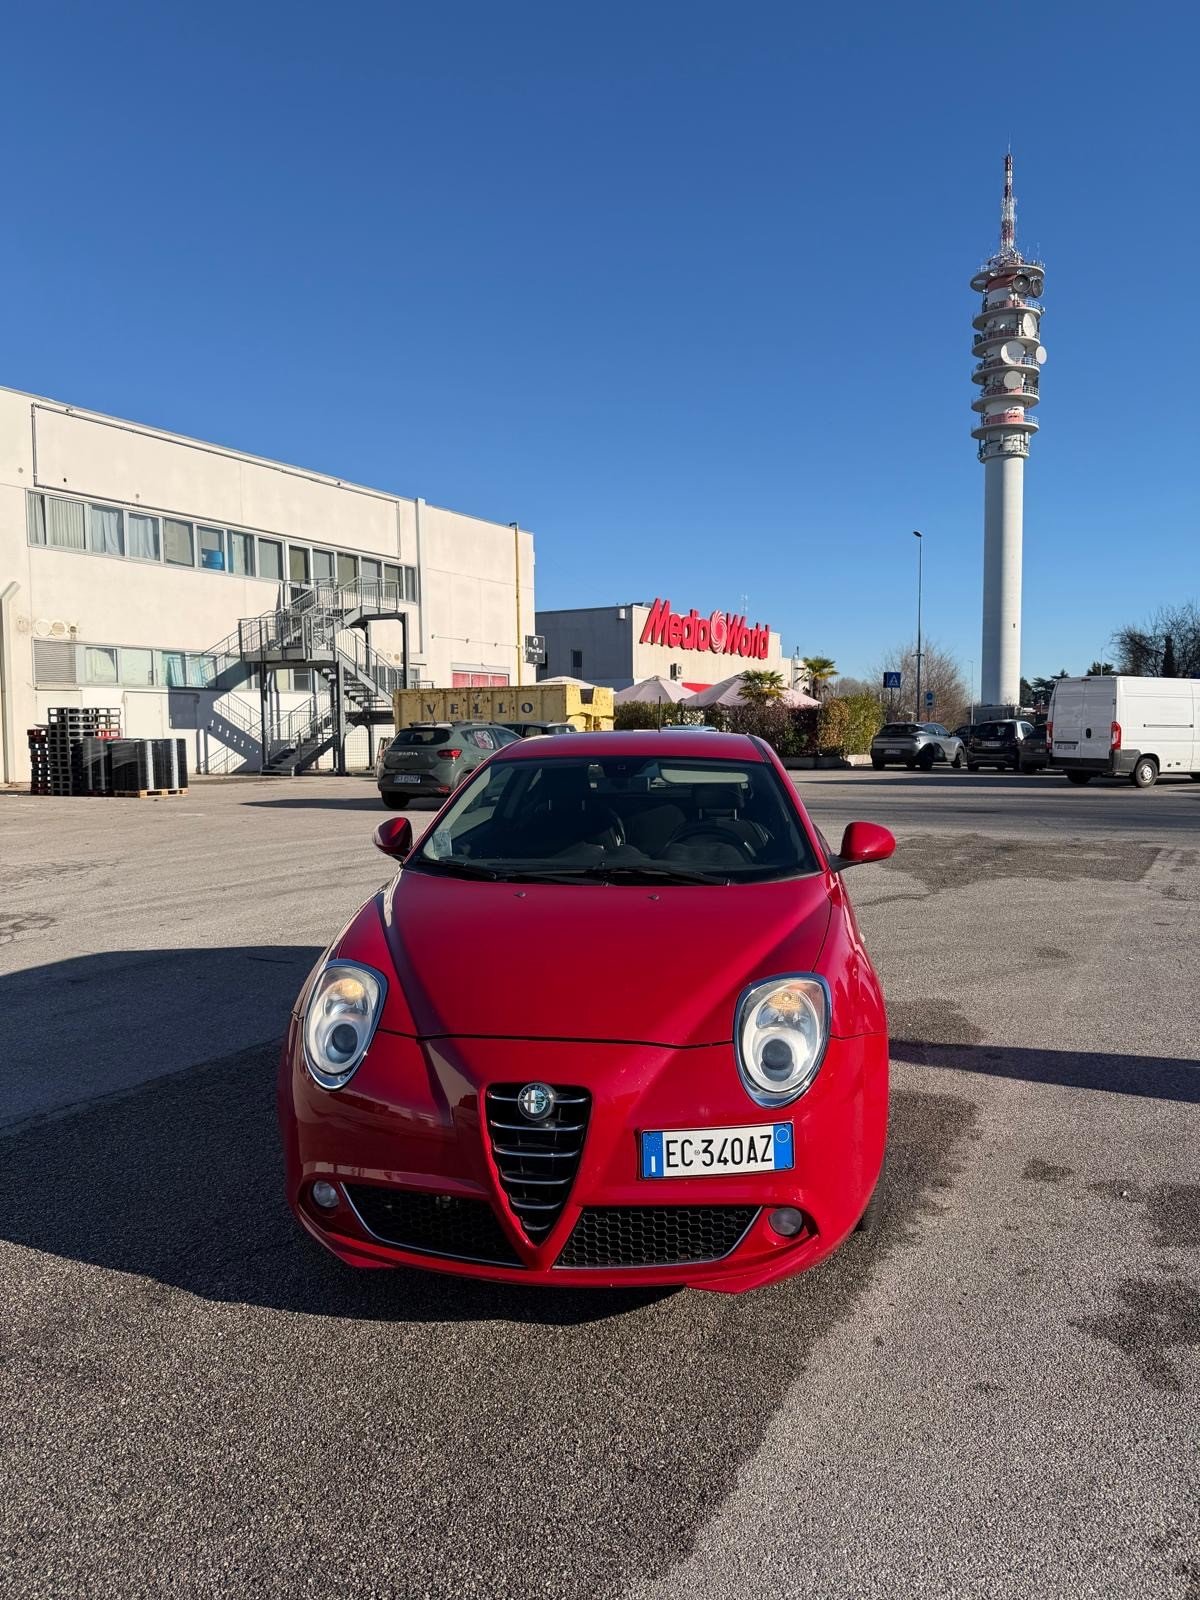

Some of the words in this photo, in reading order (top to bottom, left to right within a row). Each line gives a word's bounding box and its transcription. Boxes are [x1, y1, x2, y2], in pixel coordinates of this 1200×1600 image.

[426, 702, 534, 714] VELLO
[666, 1139, 694, 1168] EC
[701, 1134, 773, 1167] 340AZ
